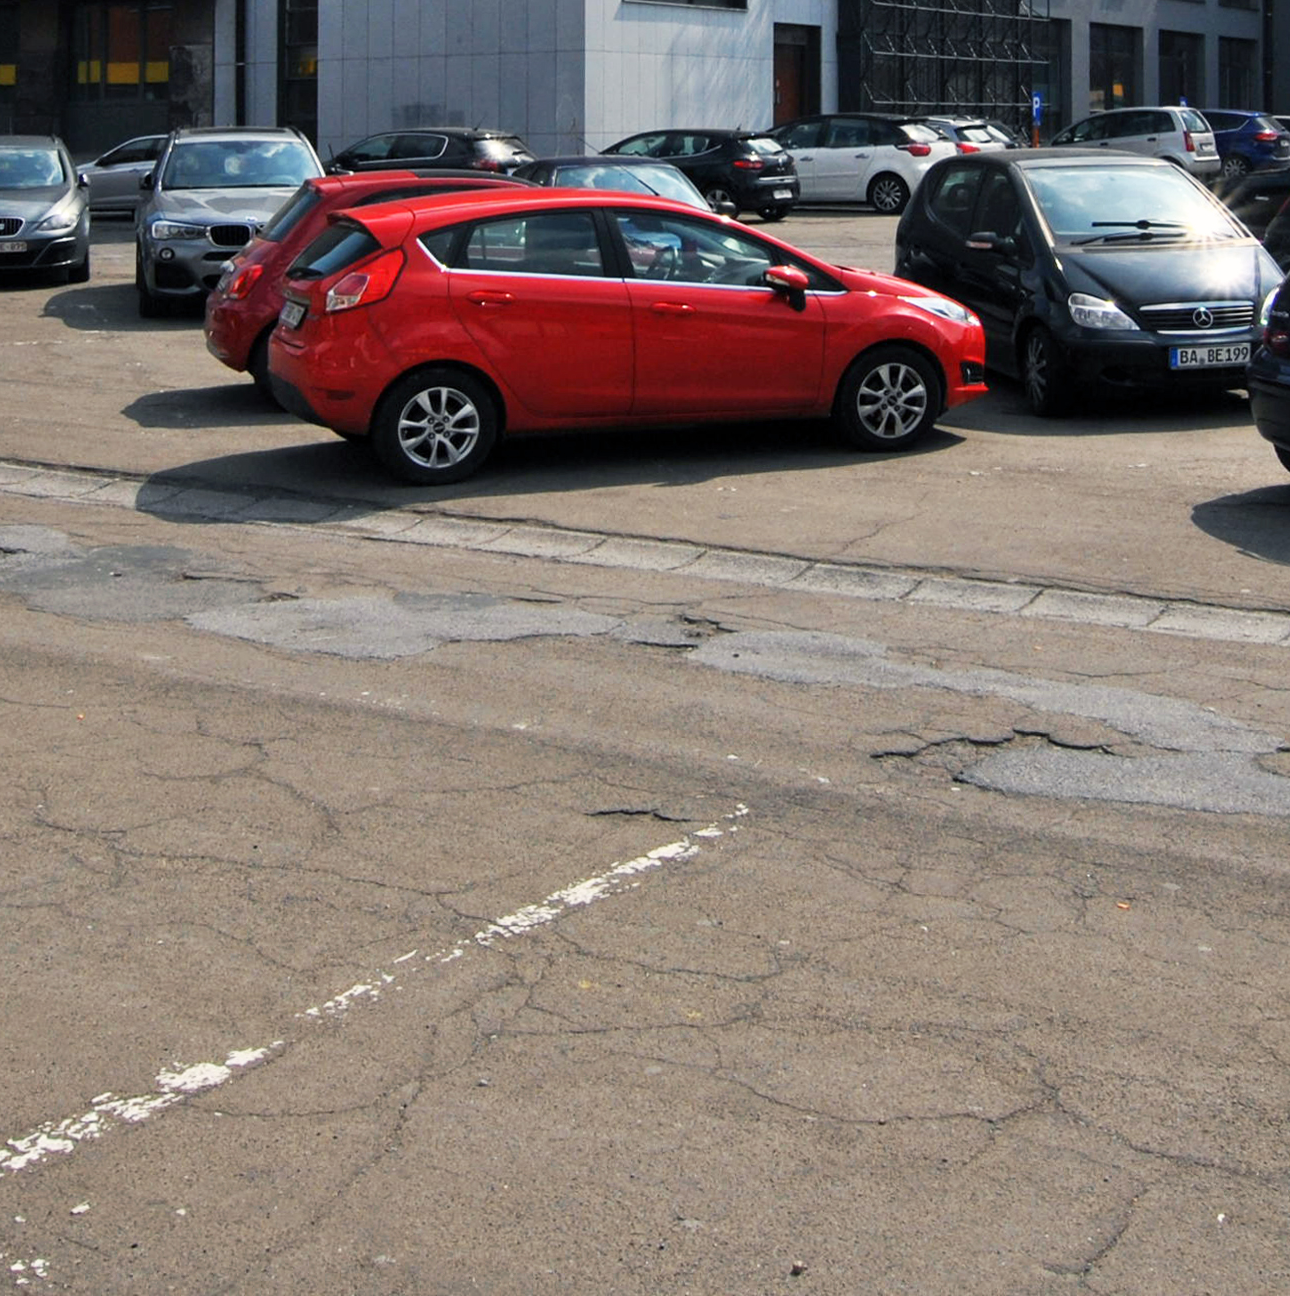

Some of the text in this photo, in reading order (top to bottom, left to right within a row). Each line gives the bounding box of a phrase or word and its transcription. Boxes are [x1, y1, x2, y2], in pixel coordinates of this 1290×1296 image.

[1033, 97, 1040, 117] P
[1180, 347, 1249, 364] BA BE199
